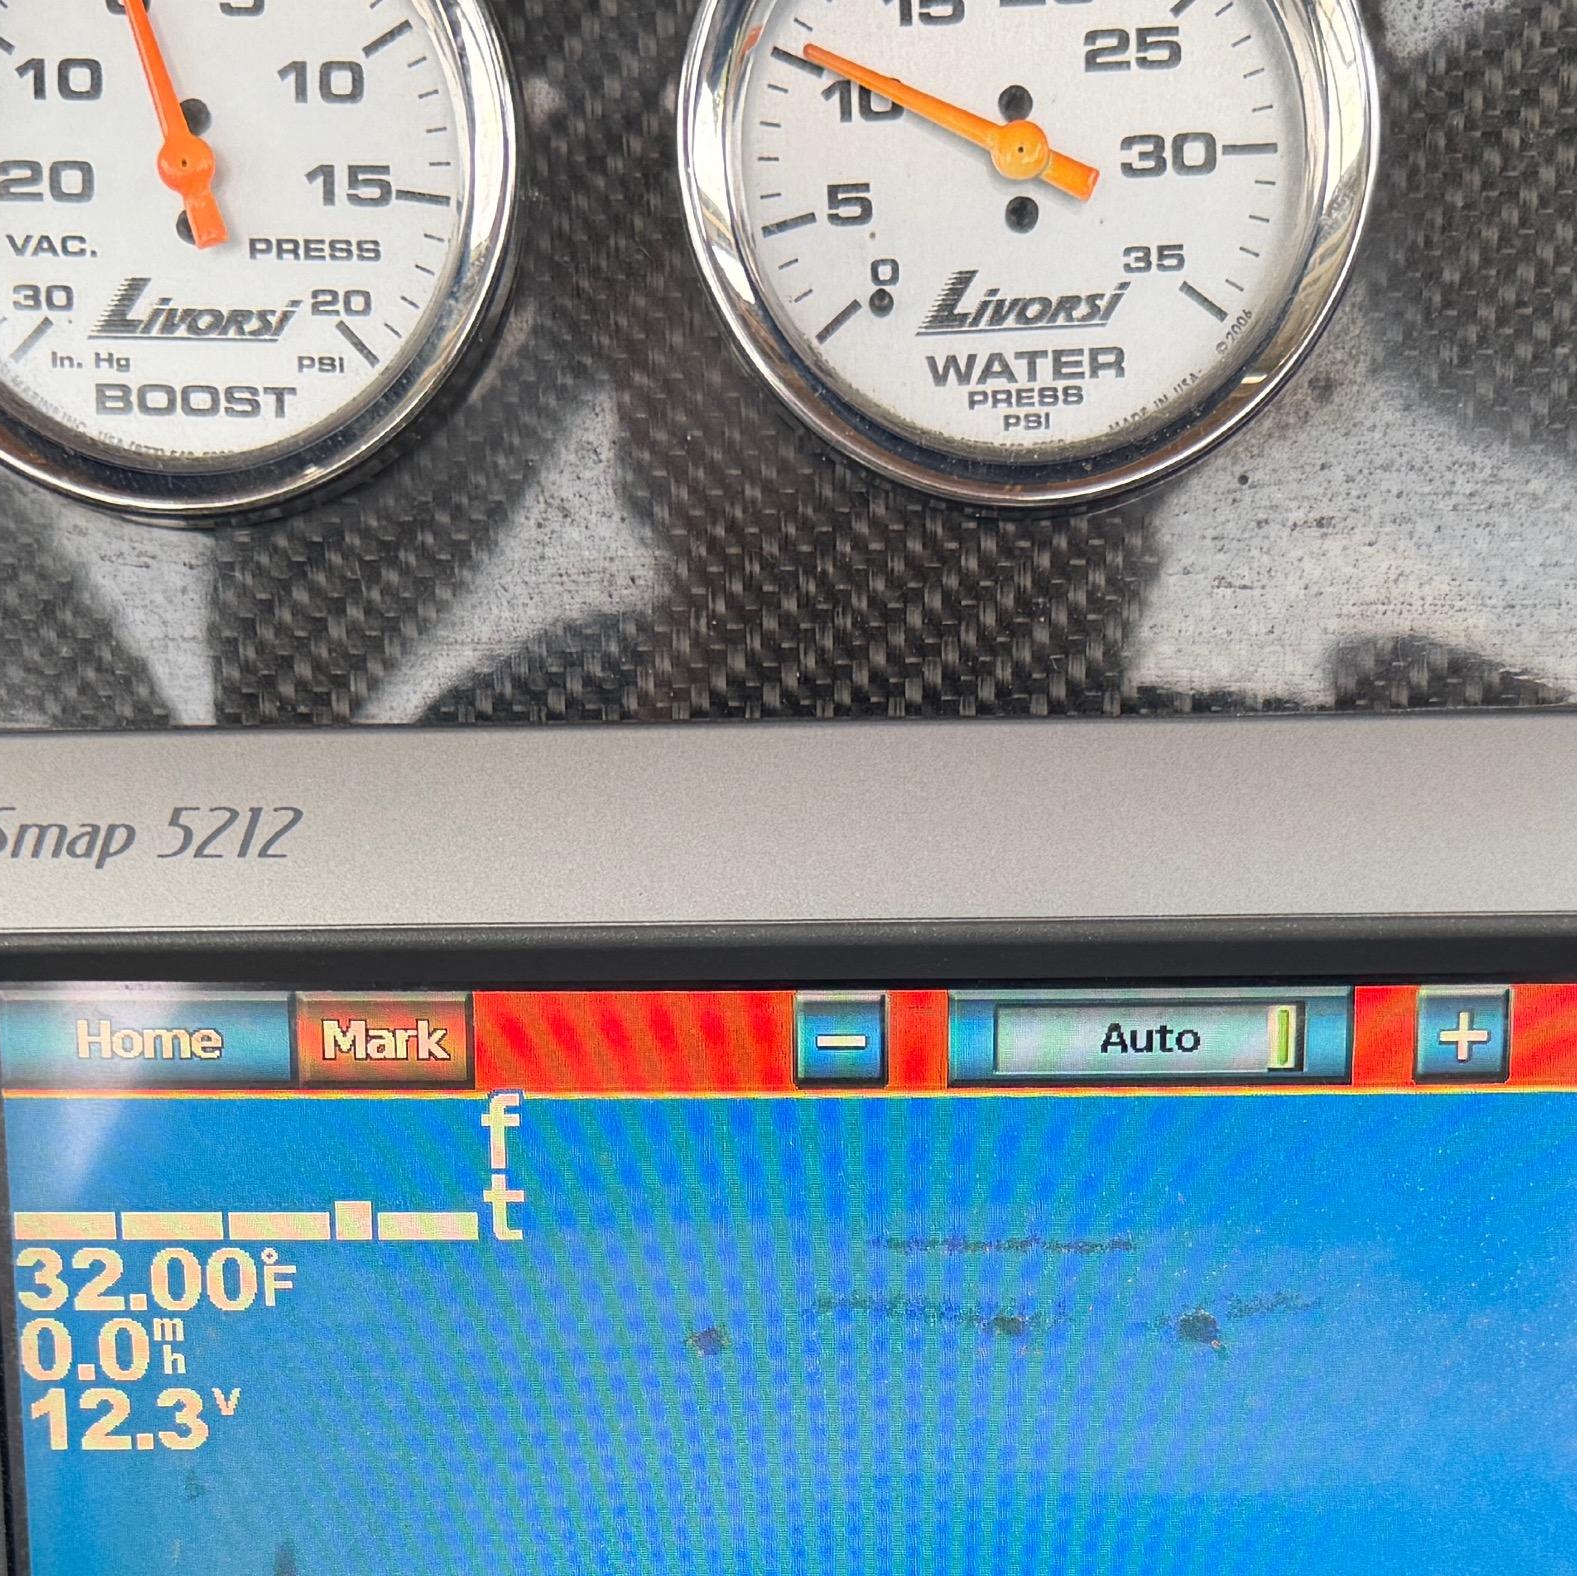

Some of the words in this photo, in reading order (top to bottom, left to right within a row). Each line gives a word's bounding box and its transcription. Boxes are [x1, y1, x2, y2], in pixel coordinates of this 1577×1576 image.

[882, 0, 965, 27] 15
[1083, 26, 1182, 73] 25
[15, 58, 102, 101] 10
[277, 60, 364, 104] 10
[1120, 132, 1217, 178] 30
[304, 164, 393, 207] 15
[826, 183, 873, 226] 5
[6, 234, 98, 259] VAC.
[248, 238, 382, 261] PRESS
[1123, 244, 1185, 274] 35
[871, 258, 899, 286] 0
[12, 284, 74, 311] 30
[310, 289, 372, 316] 20
[94, 351, 131, 373] Hg
[297, 355, 344, 374] PSI
[926, 346, 1125, 387] WATER
[95, 383, 297, 418] BOOST
[968, 385, 1084, 410] PRESS
[1003, 413, 1050, 432] PSI
[157, 806, 304, 859] 5212
[75, 1019, 222, 1060] Home
[322, 1020, 451, 1062] Mark
[1100, 1022, 1201, 1054] Auto
